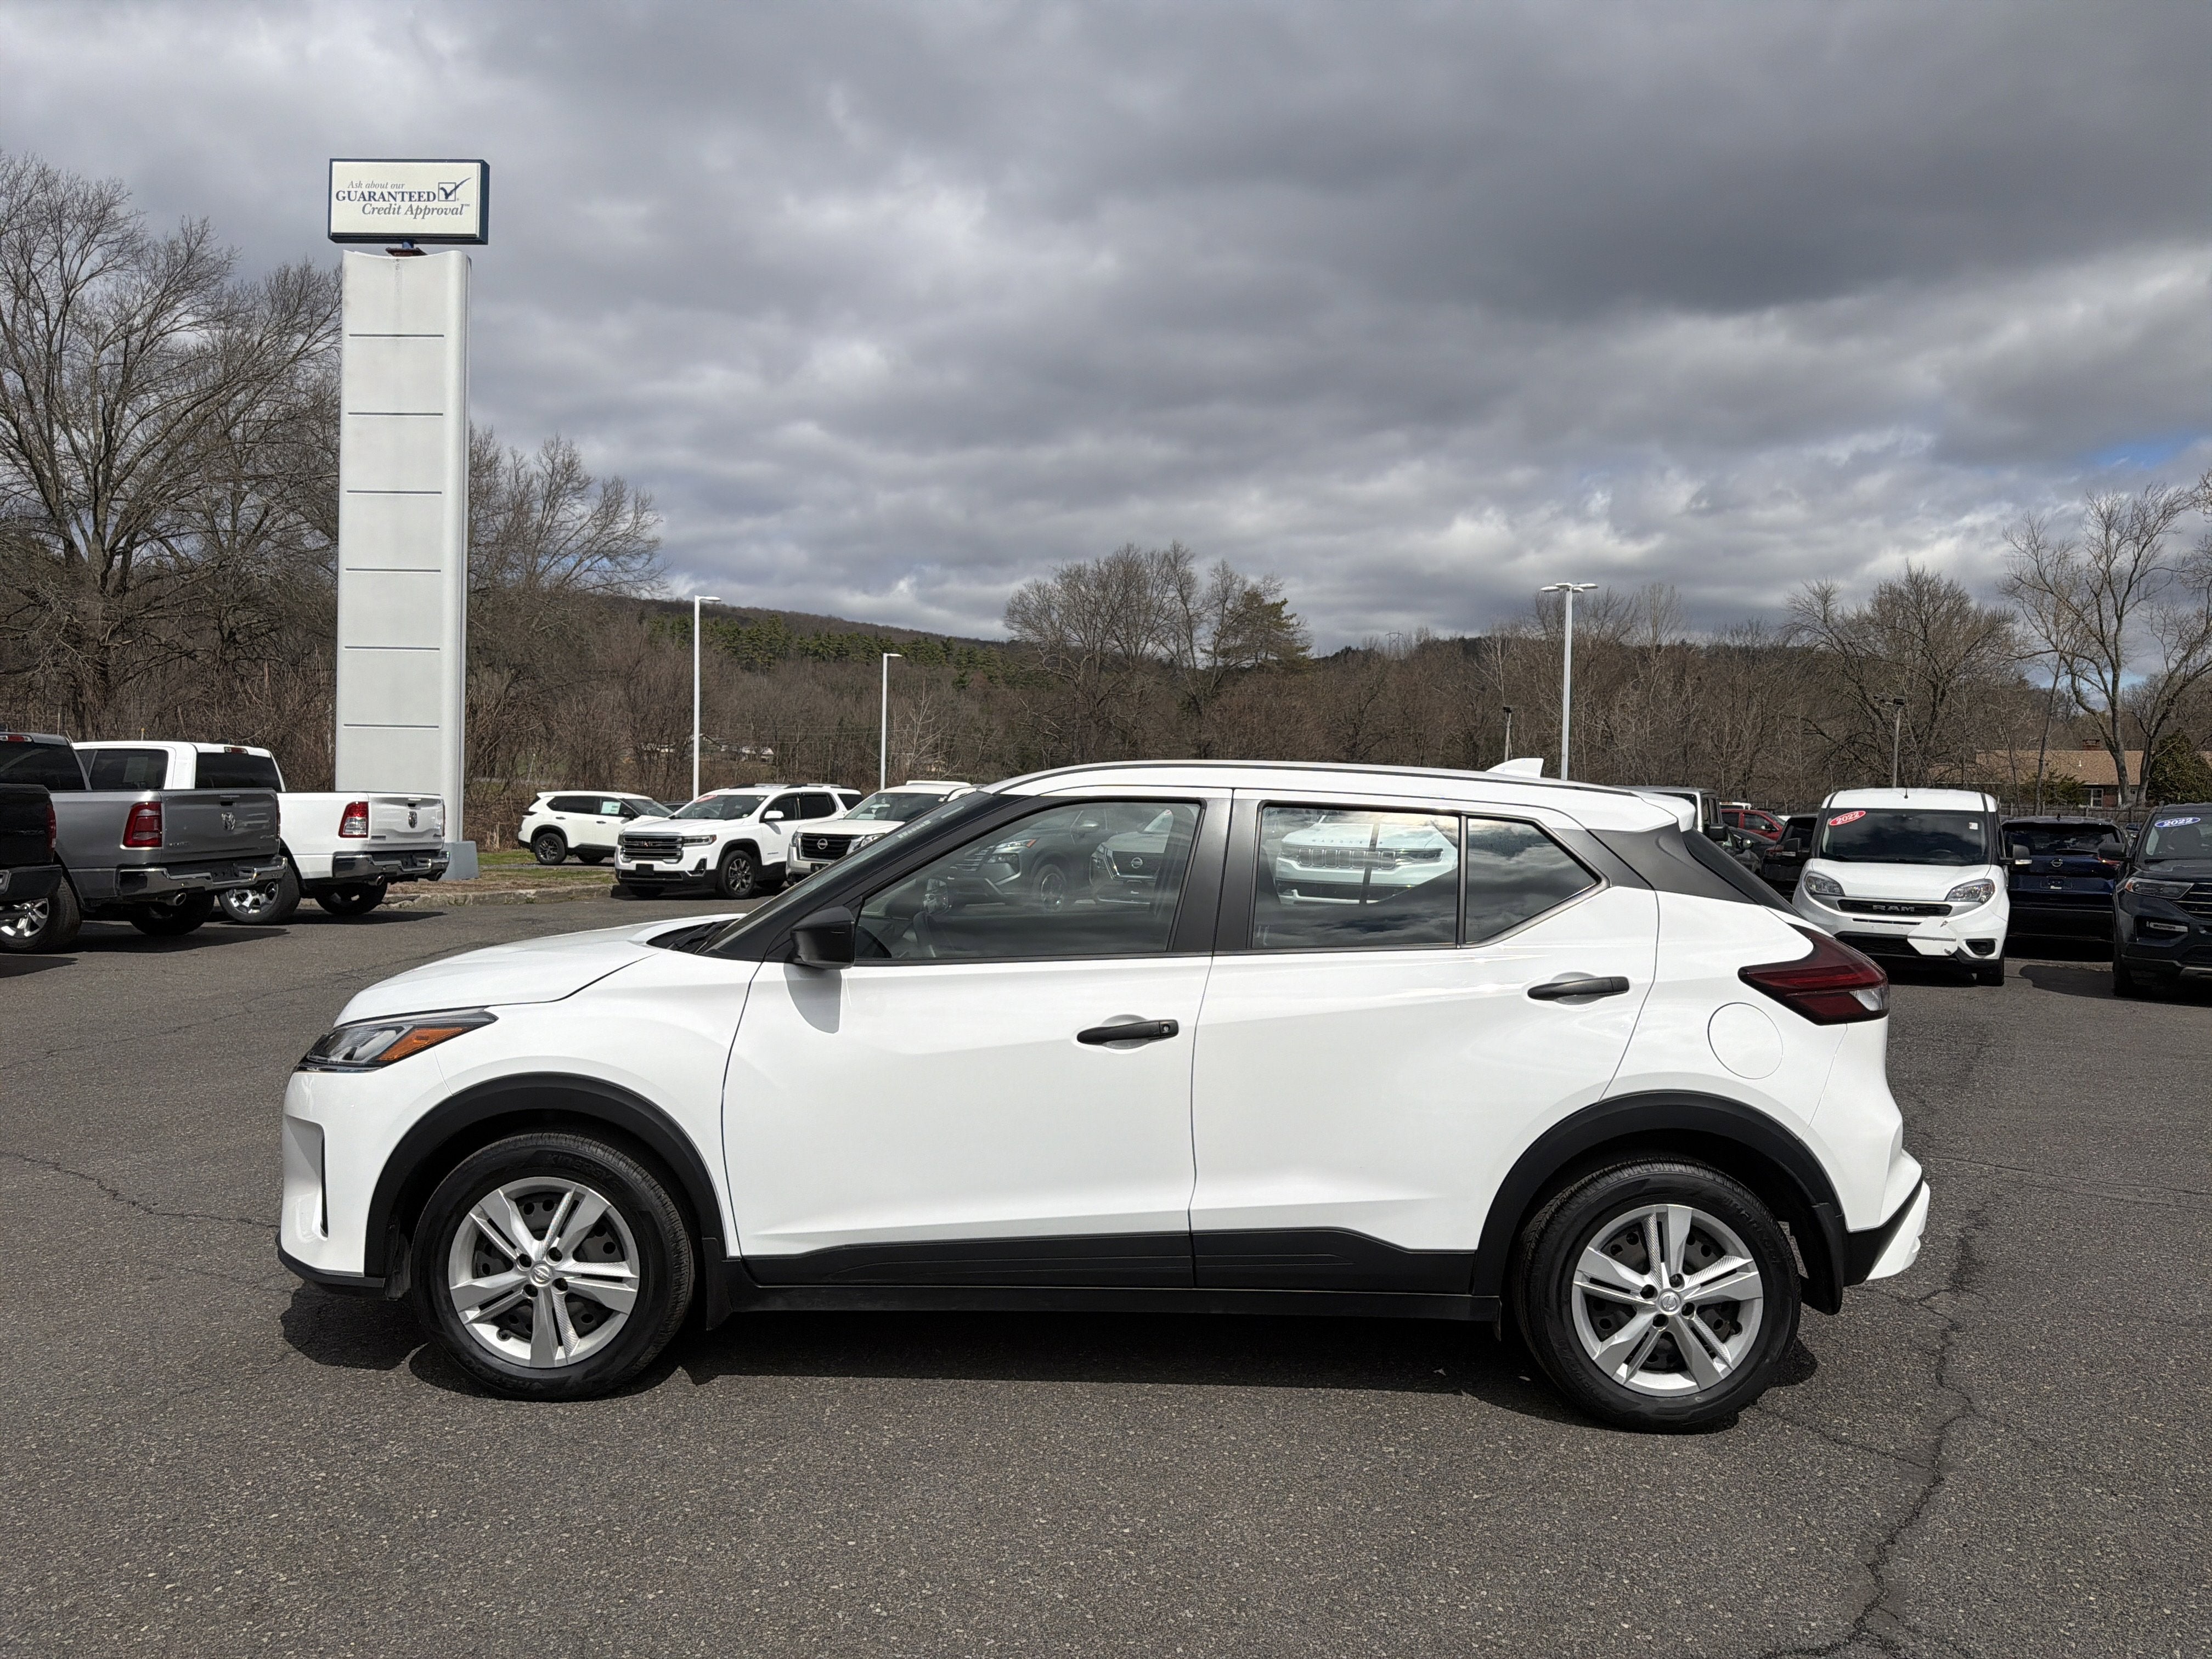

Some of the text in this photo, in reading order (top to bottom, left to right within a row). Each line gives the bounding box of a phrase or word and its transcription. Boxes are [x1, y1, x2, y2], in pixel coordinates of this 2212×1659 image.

[347, 180, 363, 189] Ask
[365, 180, 388, 189] about
[335, 190, 436, 202] GUARANTEED
[362, 203, 464, 219] Credit Approval
[1836, 811, 1859, 825] 2022
[2163, 818, 2193, 826] 2022
